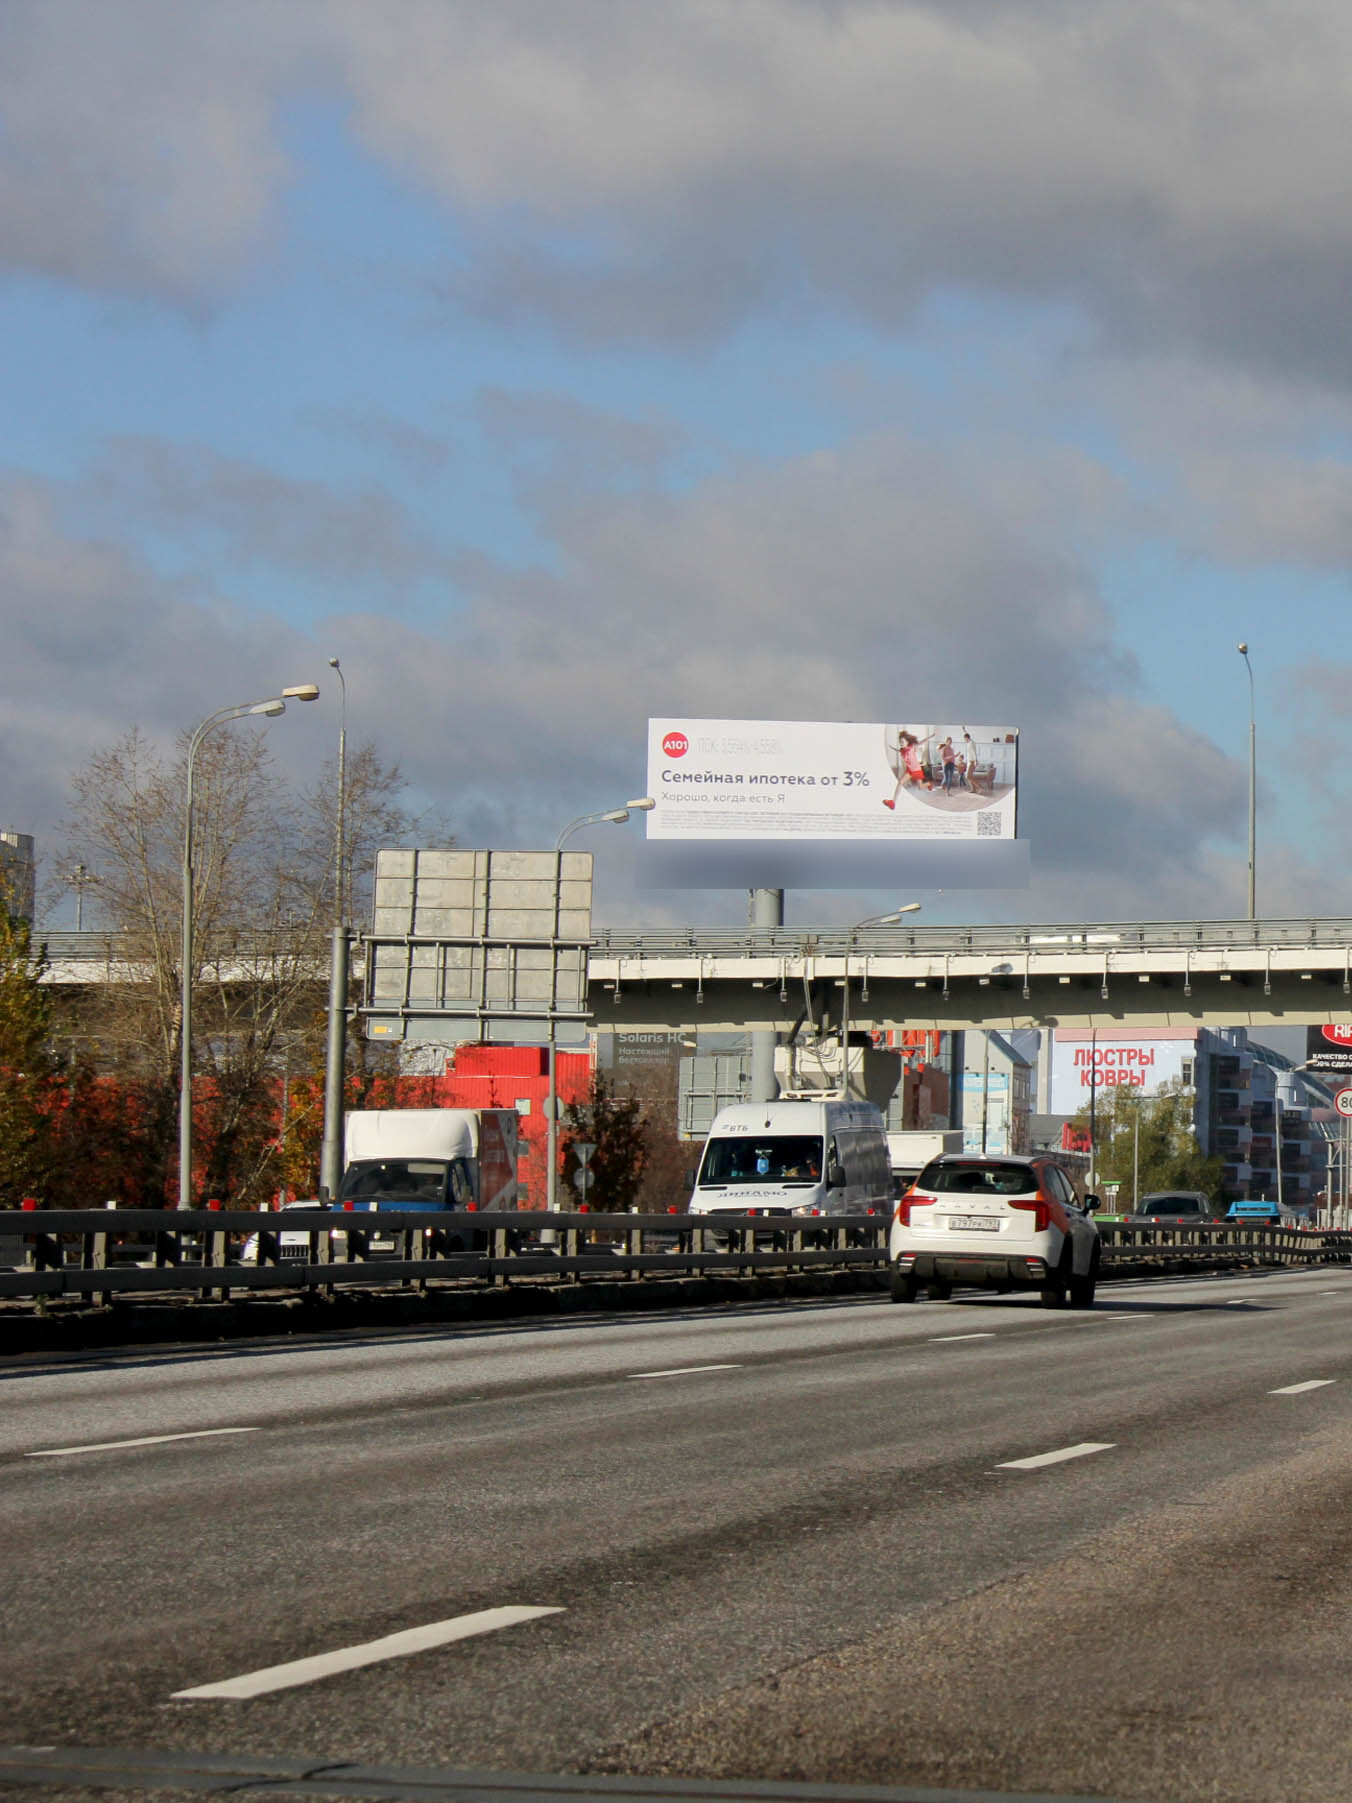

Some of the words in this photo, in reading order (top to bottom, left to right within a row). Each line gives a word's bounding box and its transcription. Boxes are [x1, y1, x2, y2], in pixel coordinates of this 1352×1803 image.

[661, 769, 744, 784] Семейная
[749, 774, 816, 786] ипотека
[820, 776, 838, 786] от
[843, 771, 871, 787] 3%
[661, 791, 710, 804] Хорошо,
[714, 794, 746, 804] когда
[749, 794, 773, 804] есть
[777, 793, 785, 803] Я
[1073, 1048, 1155, 1066] ЛЮСТРЫ
[1080, 1069, 1146, 1086] КОВРЫ
